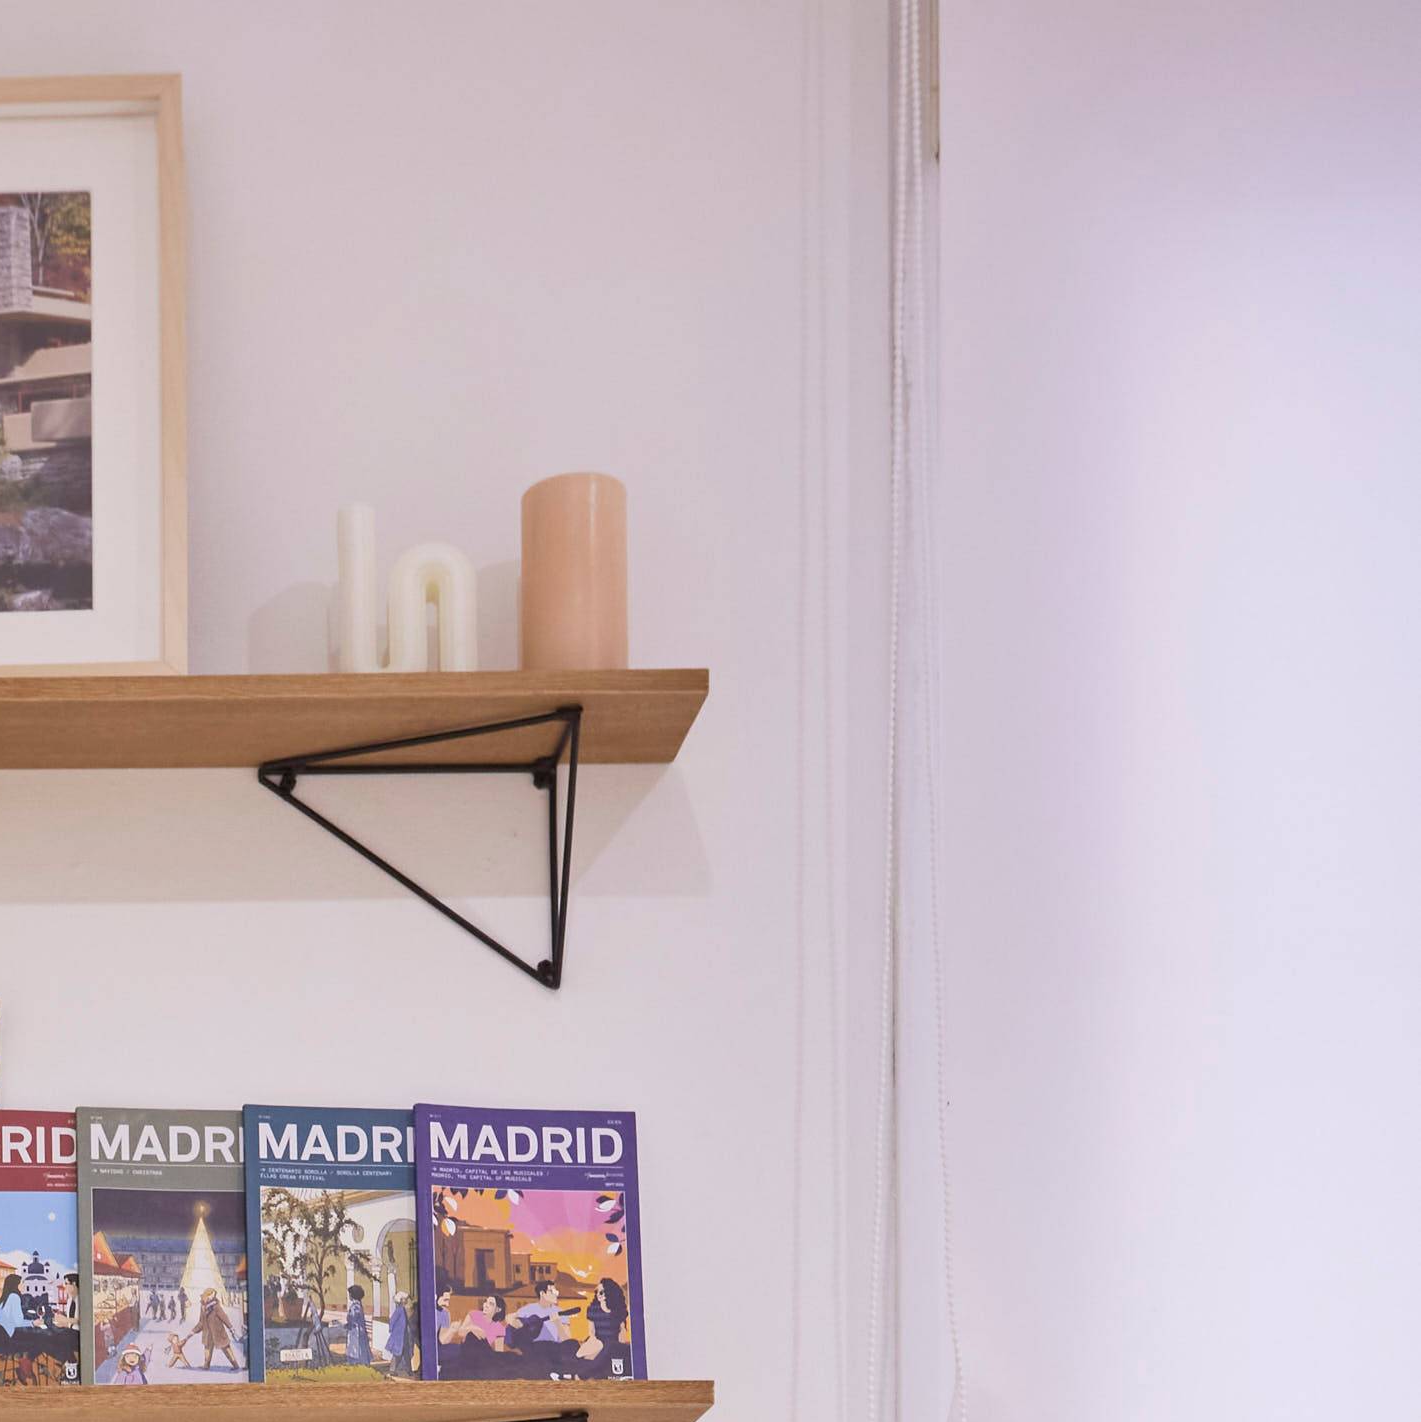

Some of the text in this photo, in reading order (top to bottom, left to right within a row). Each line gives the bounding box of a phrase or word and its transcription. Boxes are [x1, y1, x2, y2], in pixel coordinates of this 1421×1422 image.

[90, 1123, 245, 1163] MADRI
[258, 1122, 415, 1163] MADRI
[430, 1121, 623, 1164] MADRID
